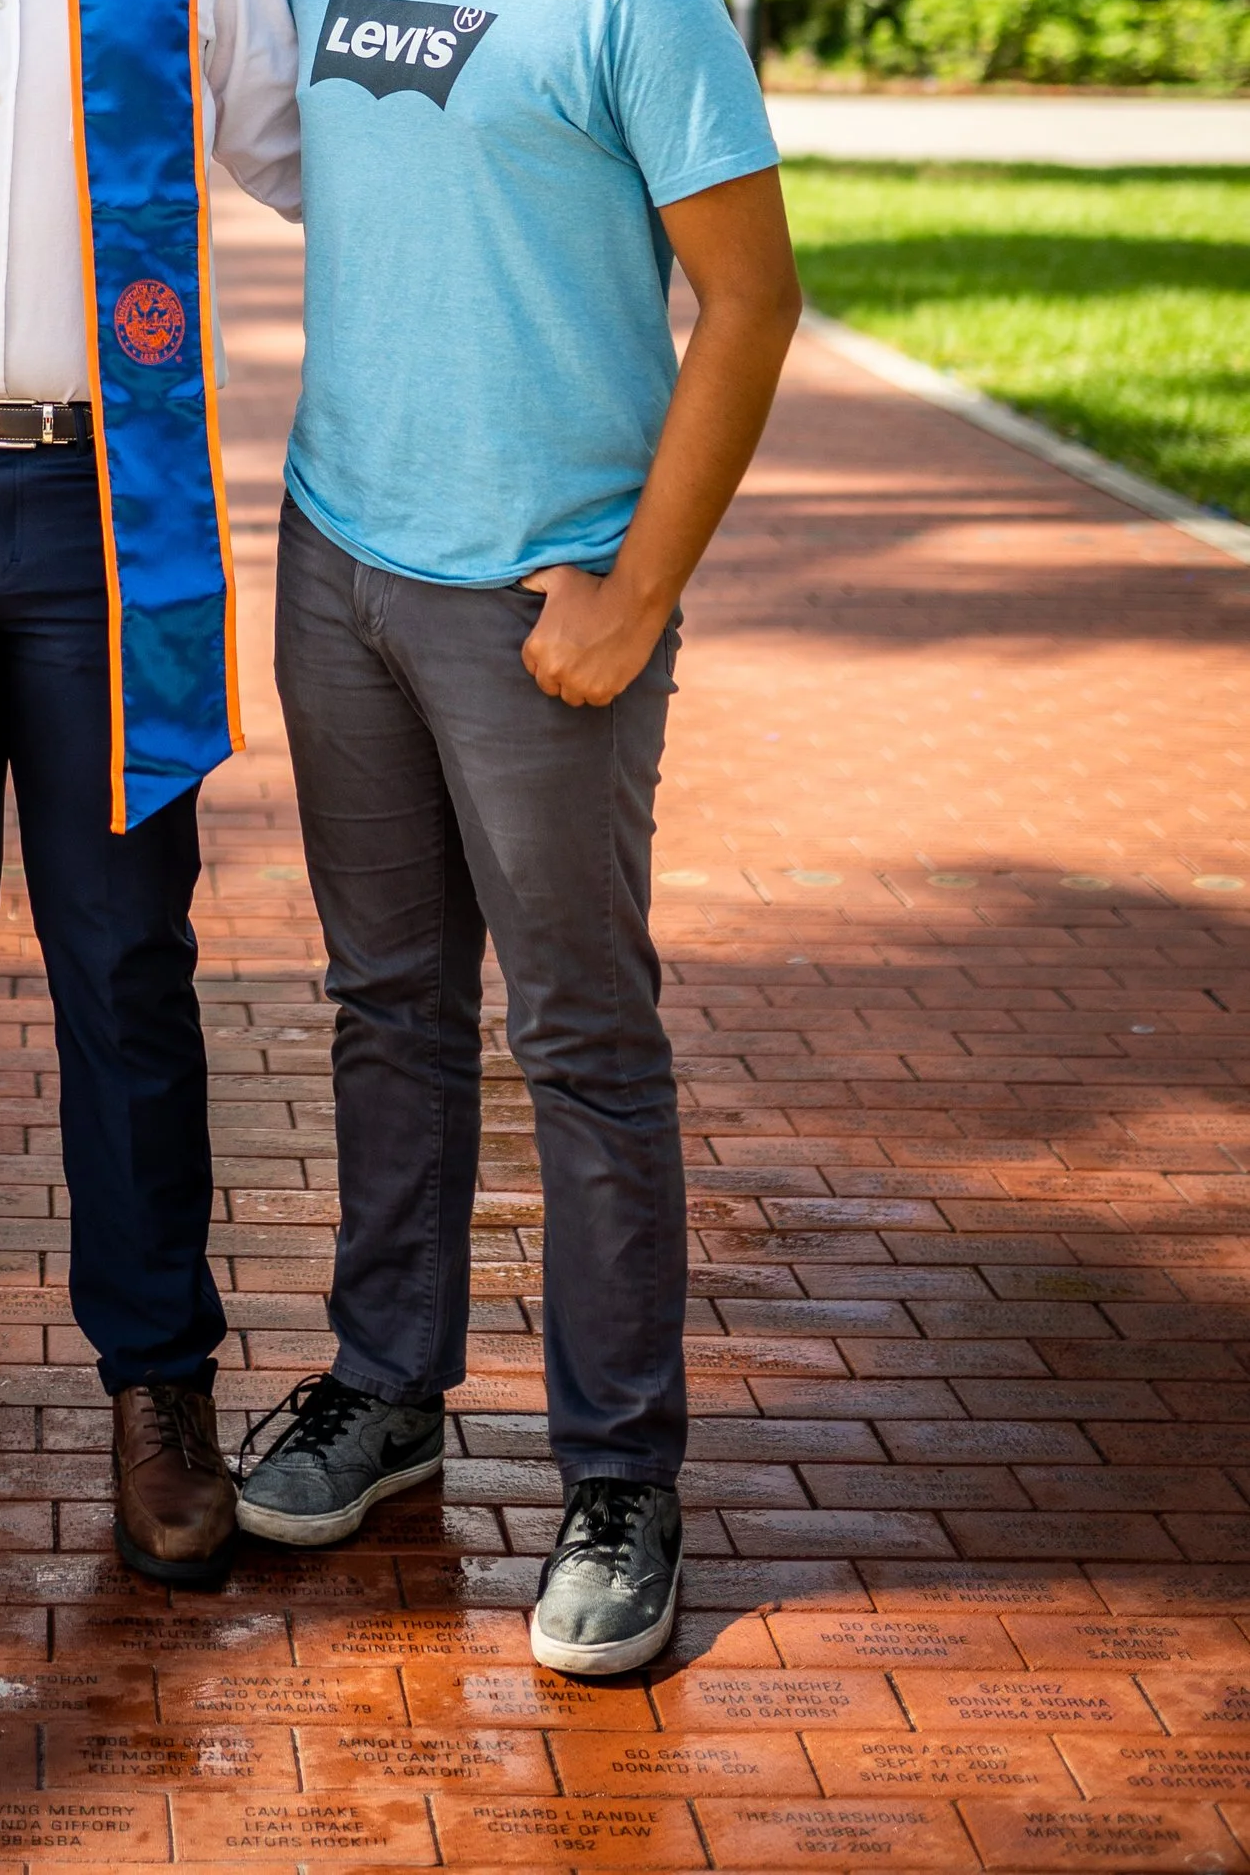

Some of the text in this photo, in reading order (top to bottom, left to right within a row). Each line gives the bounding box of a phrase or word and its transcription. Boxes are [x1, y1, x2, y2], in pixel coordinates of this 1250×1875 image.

[326, 17, 457, 69] Levi's
[839, 1622, 940, 1633] GO GATORS
[863, 1634, 901, 1644] AND
[855, 1646, 949, 1657] HARDMAN
[452, 1676, 556, 1689] JAMES KIM
[699, 1680, 844, 1692] CHRIS SANCHEZ
[978, 1683, 1063, 1694] SANCHEZ
[224, 1689, 326, 1700] GO GATORS
[532, 1690, 596, 1703] POWELL
[785, 1695, 825, 1706] PHD
[948, 1696, 1111, 1707] BONNY & NORMA
[266, 1702, 338, 1713] MACIAS
[726, 1707, 838, 1719] GO GATORS!
[960, 1710, 1112, 1721] BSPH54 BSBA 55
[183, 1737, 255, 1748] GATORS
[338, 1738, 514, 1751] ARNOLD WILLIAMS
[624, 1749, 740, 1761] GO GATORS!
[861, 1744, 1009, 1755] BORN A GATOR!
[1120, 1749, 1188, 1759] CURT &
[80, 1750, 188, 1761] THE MOORE
[351, 1751, 453, 1763] YOU CAN'T
[612, 1761, 759, 1775] DONALD COX
[968, 1759, 1008, 1769] 2007
[209, 1765, 255, 1776] LUKE
[383, 1765, 396, 1776] A
[860, 1772, 1040, 1784] SHANE KEOGH
[1127, 1776, 1235, 1788] GO GATORS
[49, 1805, 135, 1817] MEMORY
[297, 1807, 360, 1818] DRAKE
[474, 1807, 659, 1823] RICHARD RANDLE
[50, 1821, 131, 1832] GIFFORD
[246, 1821, 364, 1832] LEAH DRAKE
[488, 1822, 651, 1837] COLLEGE OF LAW
[30, 1835, 82, 1846] BSBA
[226, 1835, 303, 1847] GATORS
[552, 1839, 597, 1850] 1952
